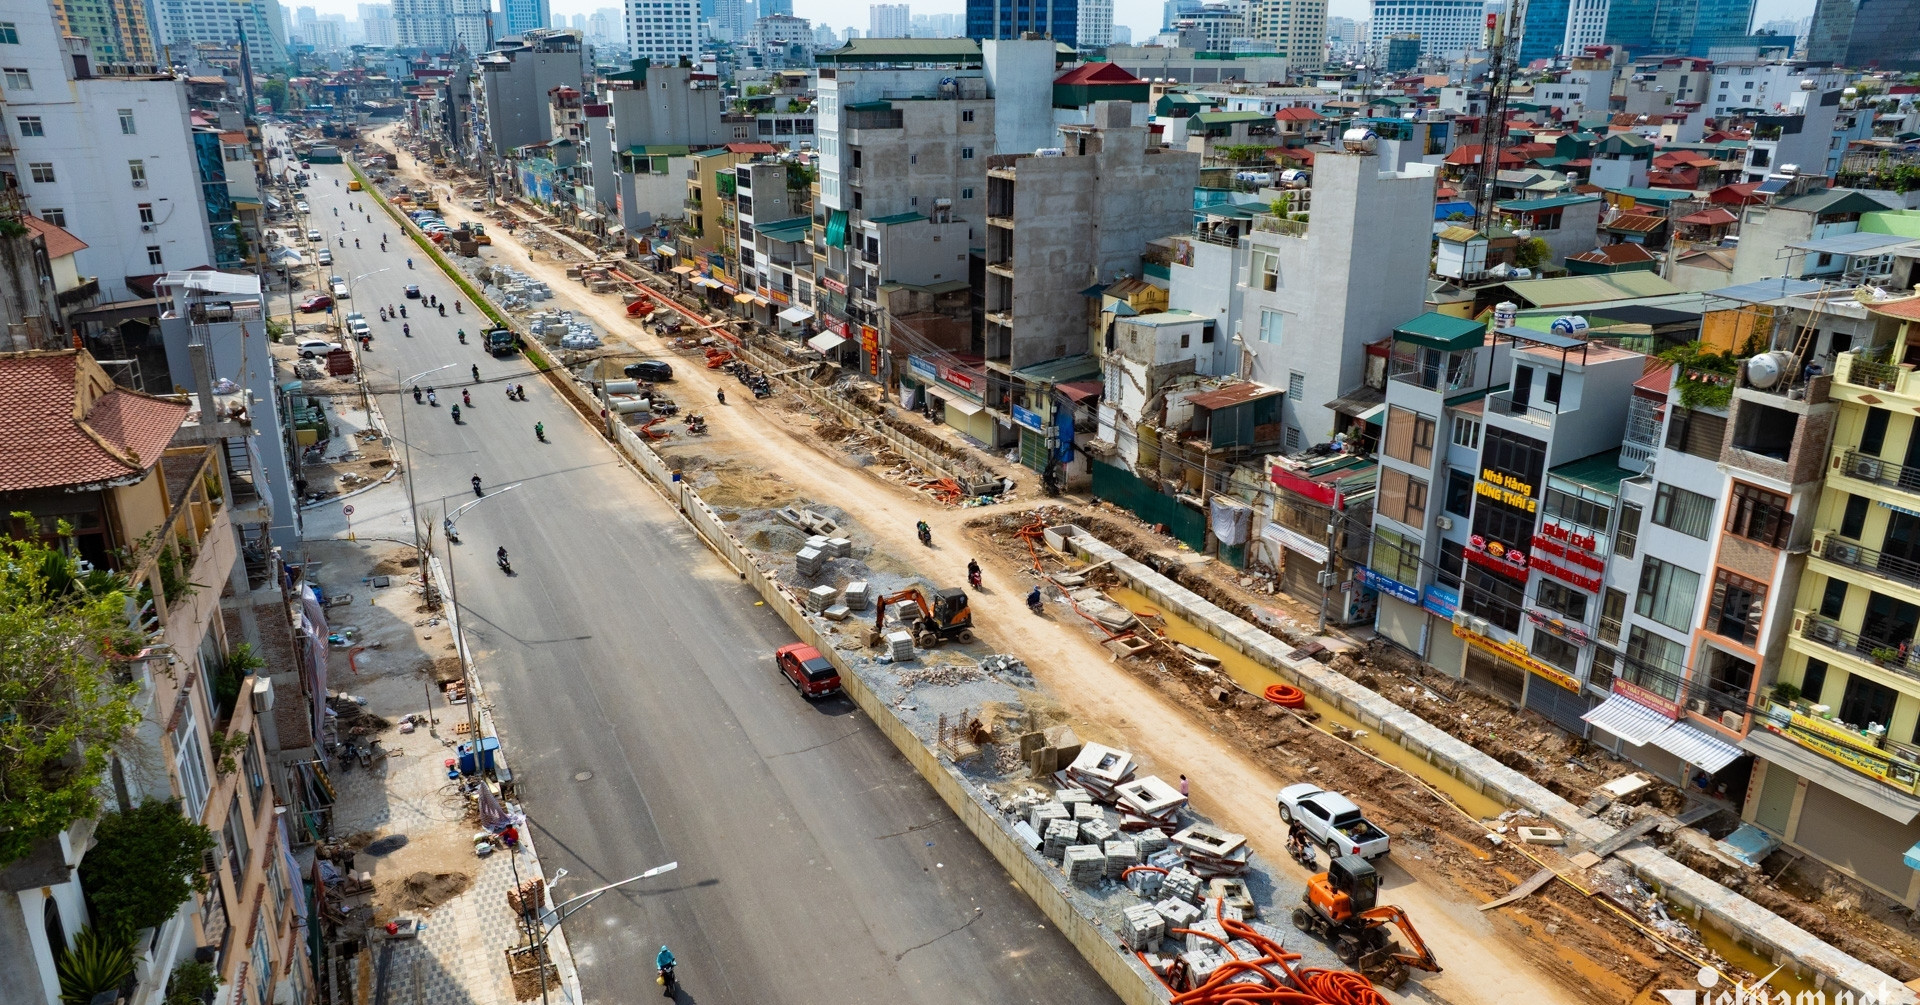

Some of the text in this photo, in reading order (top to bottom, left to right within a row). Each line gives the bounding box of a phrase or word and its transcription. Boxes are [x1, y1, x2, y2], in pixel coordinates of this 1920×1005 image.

[1482, 468, 1532, 497] Nhà Hàng
[1503, 491, 1527, 509] THÁI
[1527, 500, 1537, 513] 2
[1543, 522, 1596, 552] BÚN CHẢ
